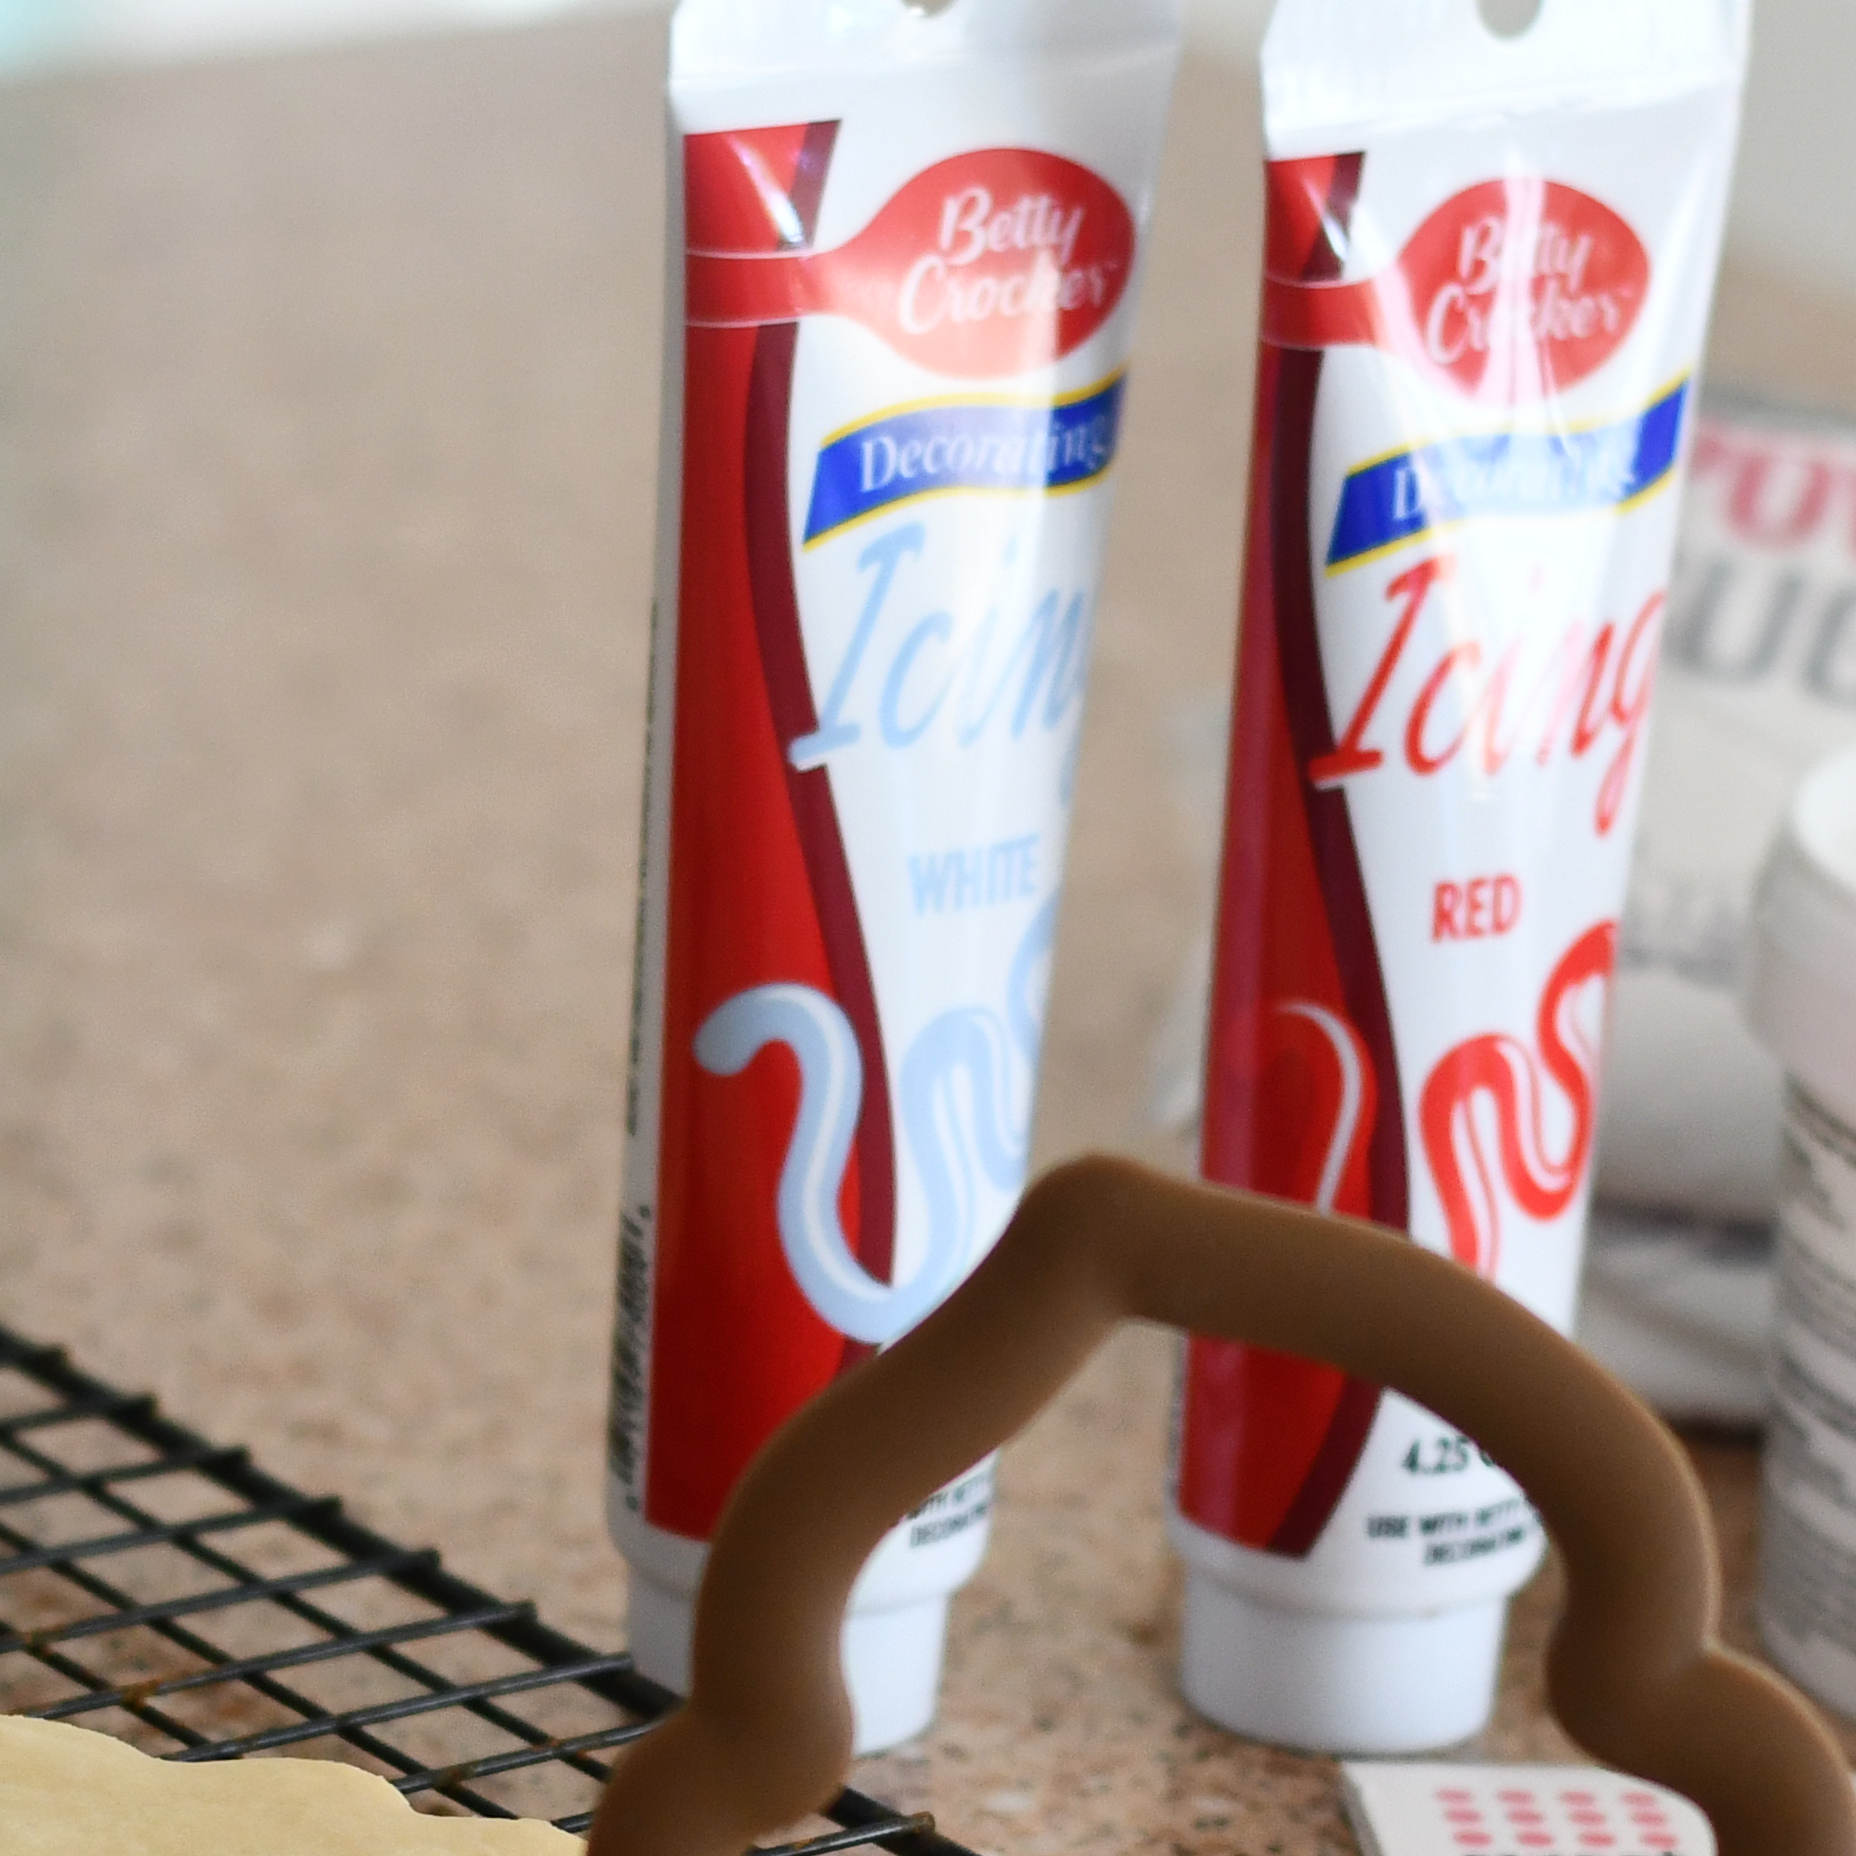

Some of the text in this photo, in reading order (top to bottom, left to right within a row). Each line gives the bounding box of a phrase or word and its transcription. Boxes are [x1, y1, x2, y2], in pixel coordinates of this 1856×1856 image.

[937, 186, 1086, 266] Betty
[897, 253, 1108, 336] Crocker
[788, 520, 1090, 807] Icin
[1308, 552, 1669, 840] Icing
[905, 832, 1041, 916] WHITE
[1431, 872, 1524, 944] RED
[1401, 1436, 1470, 1476] 4.25
